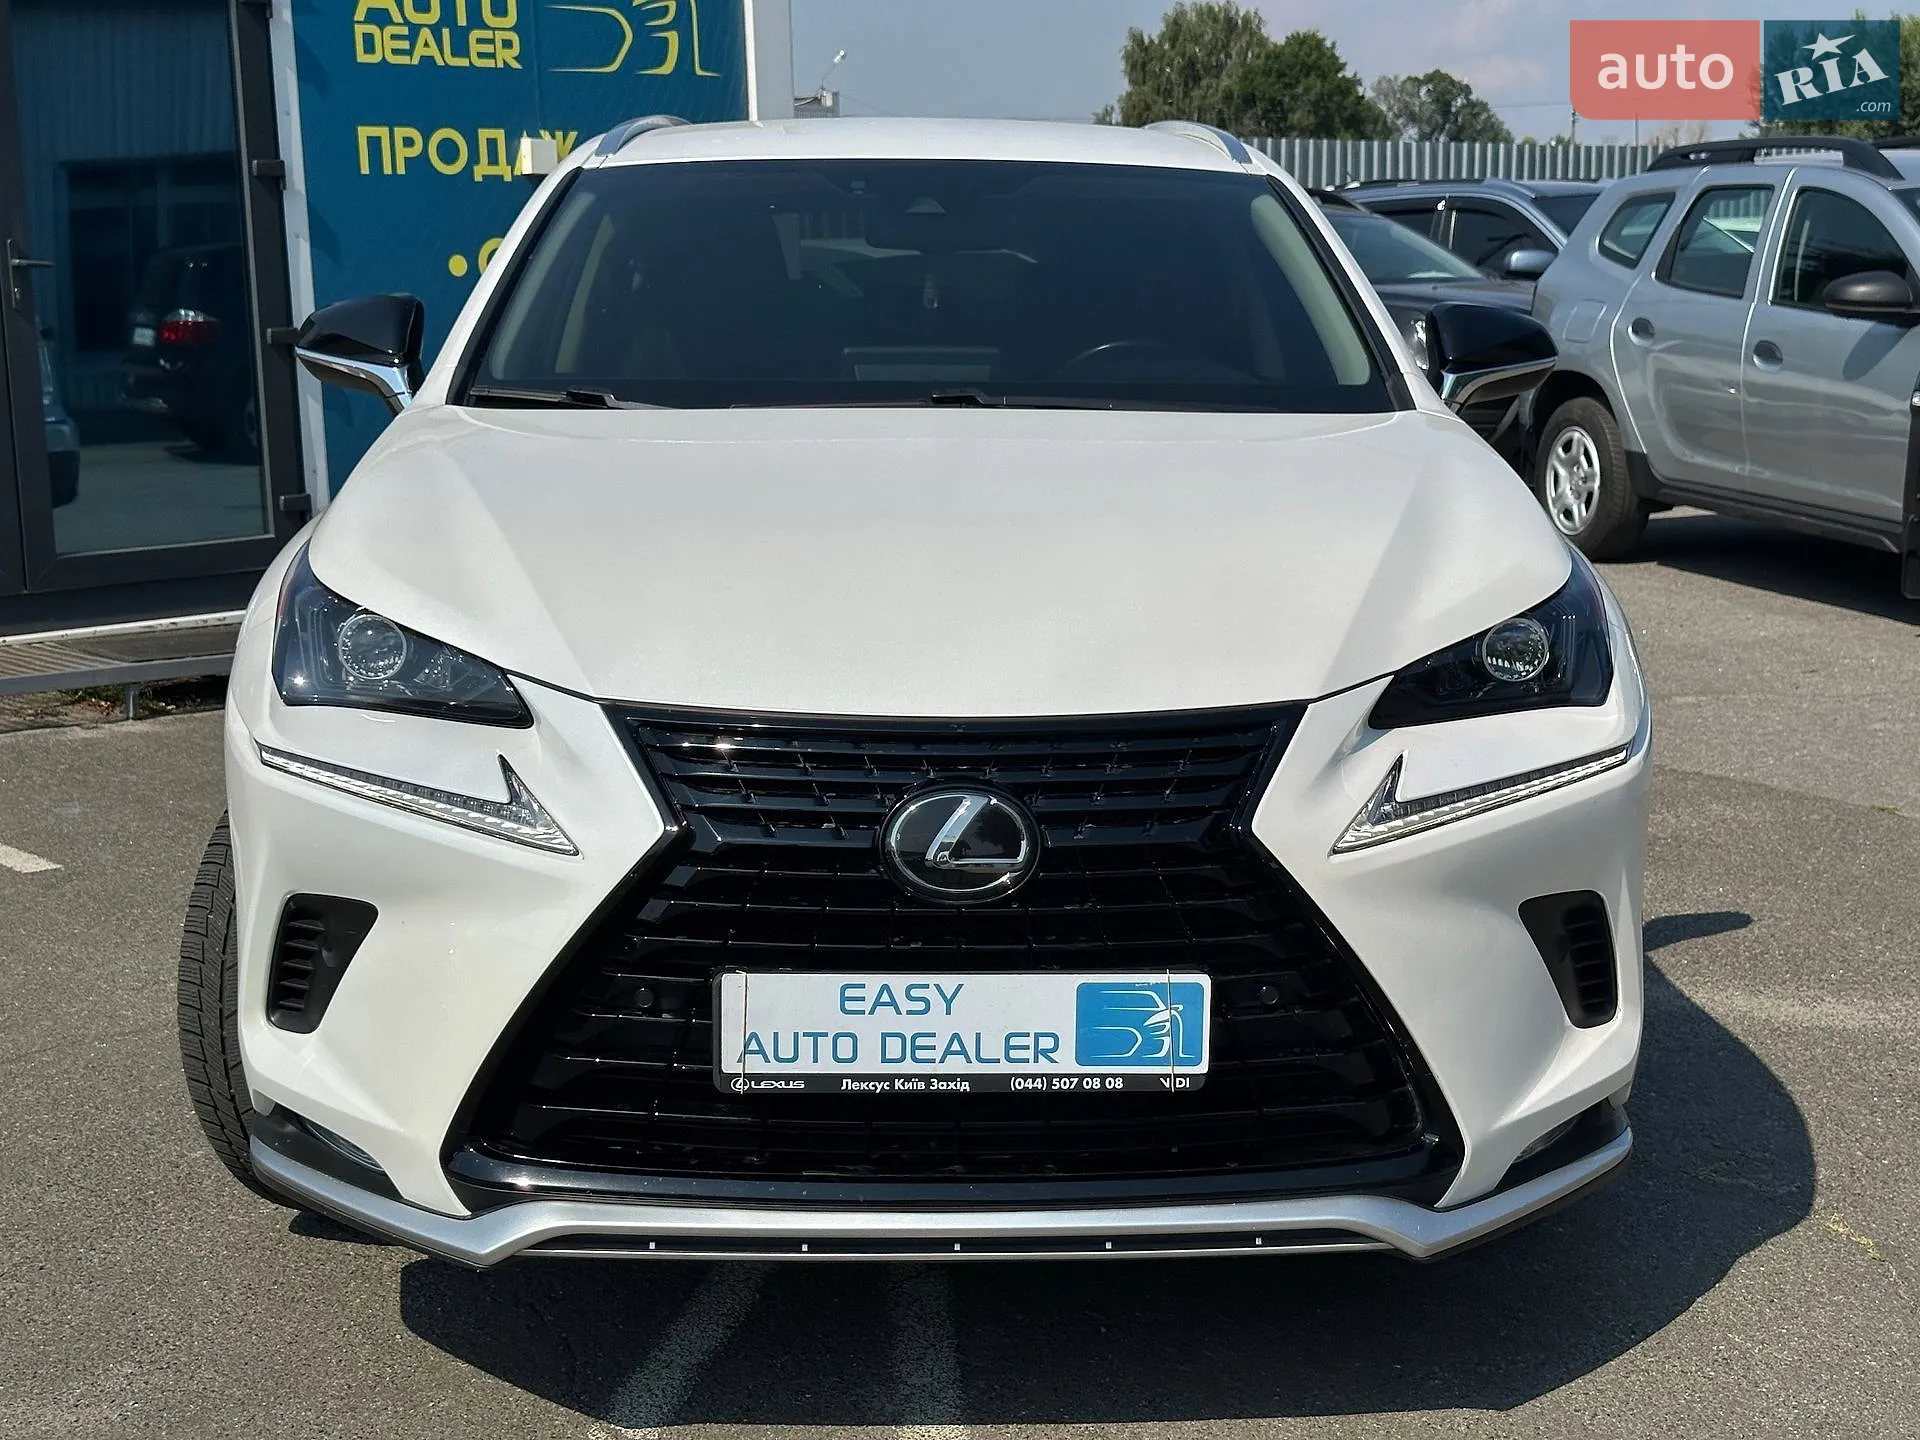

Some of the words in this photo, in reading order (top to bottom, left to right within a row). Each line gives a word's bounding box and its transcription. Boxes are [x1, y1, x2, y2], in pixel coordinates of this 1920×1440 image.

[354, 24, 523, 69] DEALER
[356, 125, 579, 183] ПРОД
[839, 983, 964, 1016] EASY
[737, 1031, 858, 1064] AUTO
[880, 1031, 1060, 1064] DEALER
[750, 1080, 806, 1089] LEXUS
[841, 1078, 890, 1093] Лексус
[894, 1078, 926, 1091] Київ
[930, 1078, 970, 1092] Захід
[1010, 1076, 1048, 1091] (044)
[1051, 1077, 1079, 1090] 507
[1082, 1077, 1101, 1090] 08
[1105, 1077, 1124, 1090] 08
